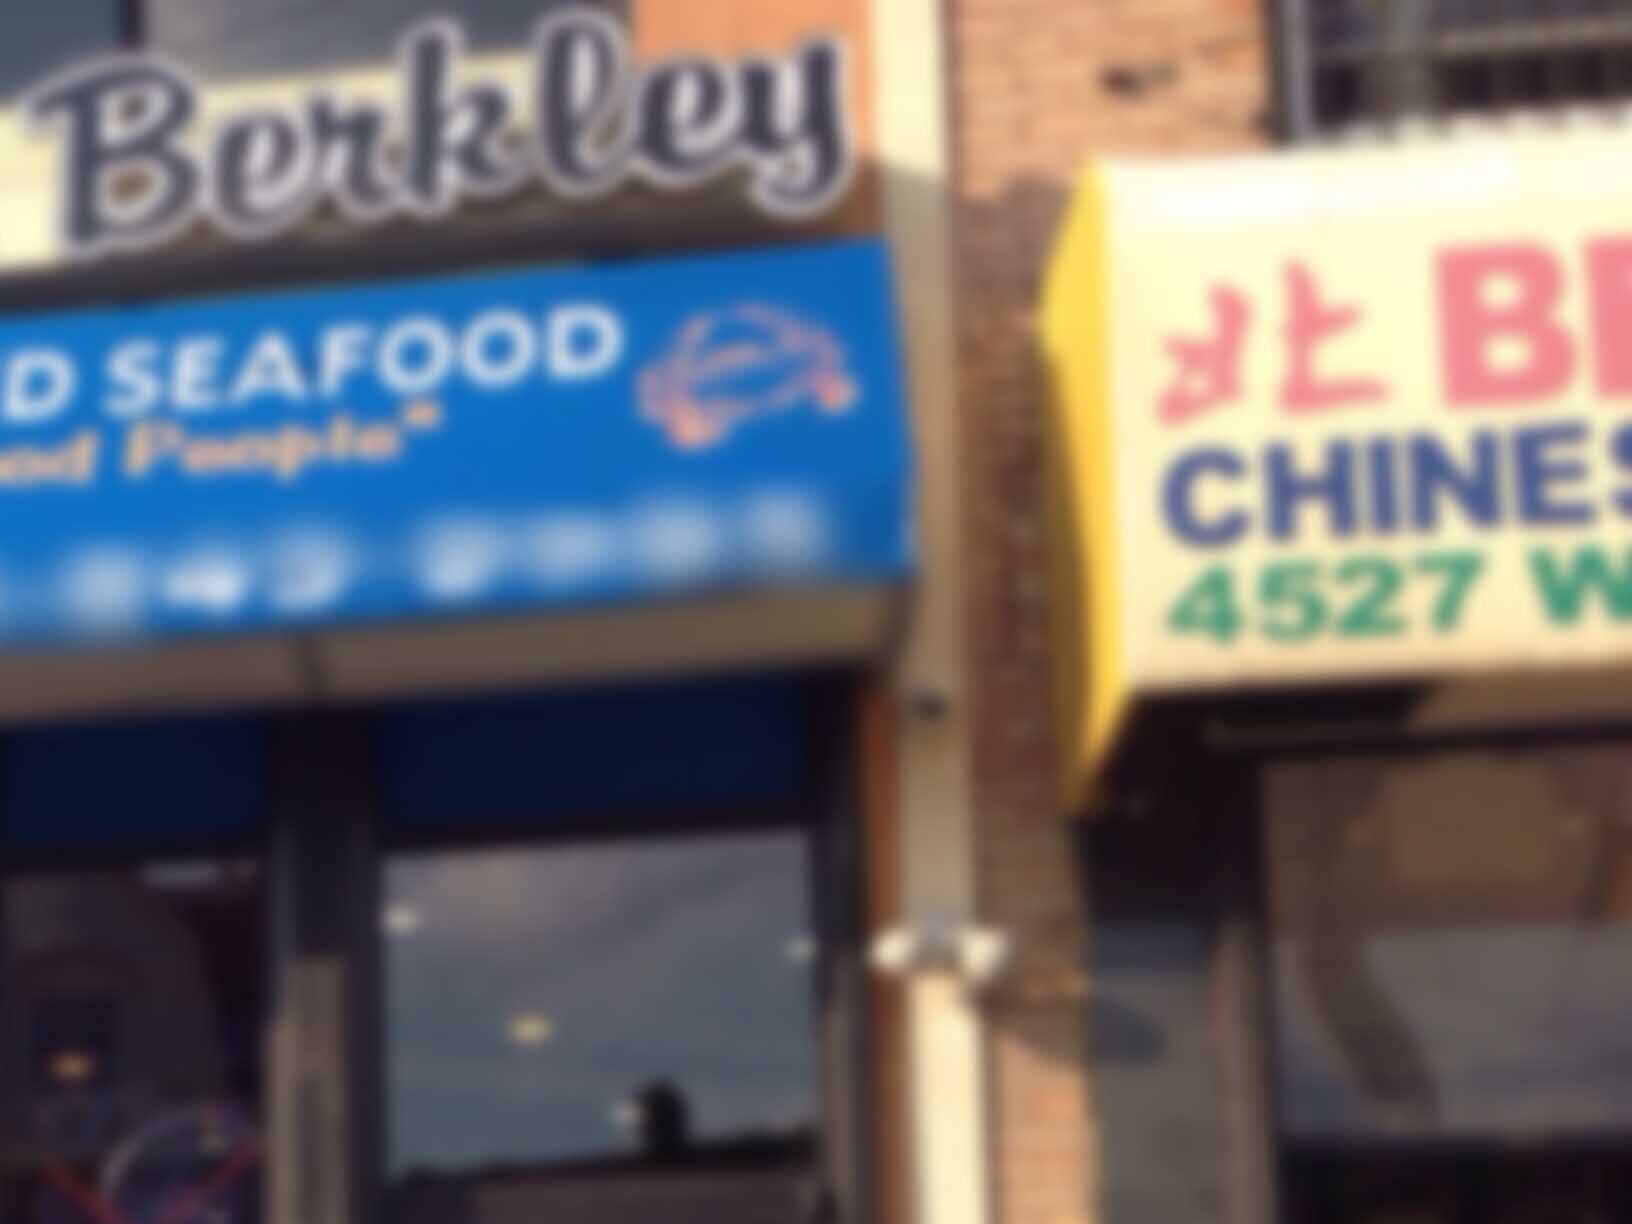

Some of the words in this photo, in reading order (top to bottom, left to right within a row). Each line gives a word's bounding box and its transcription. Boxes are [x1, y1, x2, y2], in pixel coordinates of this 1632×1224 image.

[21, 8, 856, 258] Berkley
[101, 302, 624, 416] SEAFOOD
[1164, 546, 1484, 646] 4527
